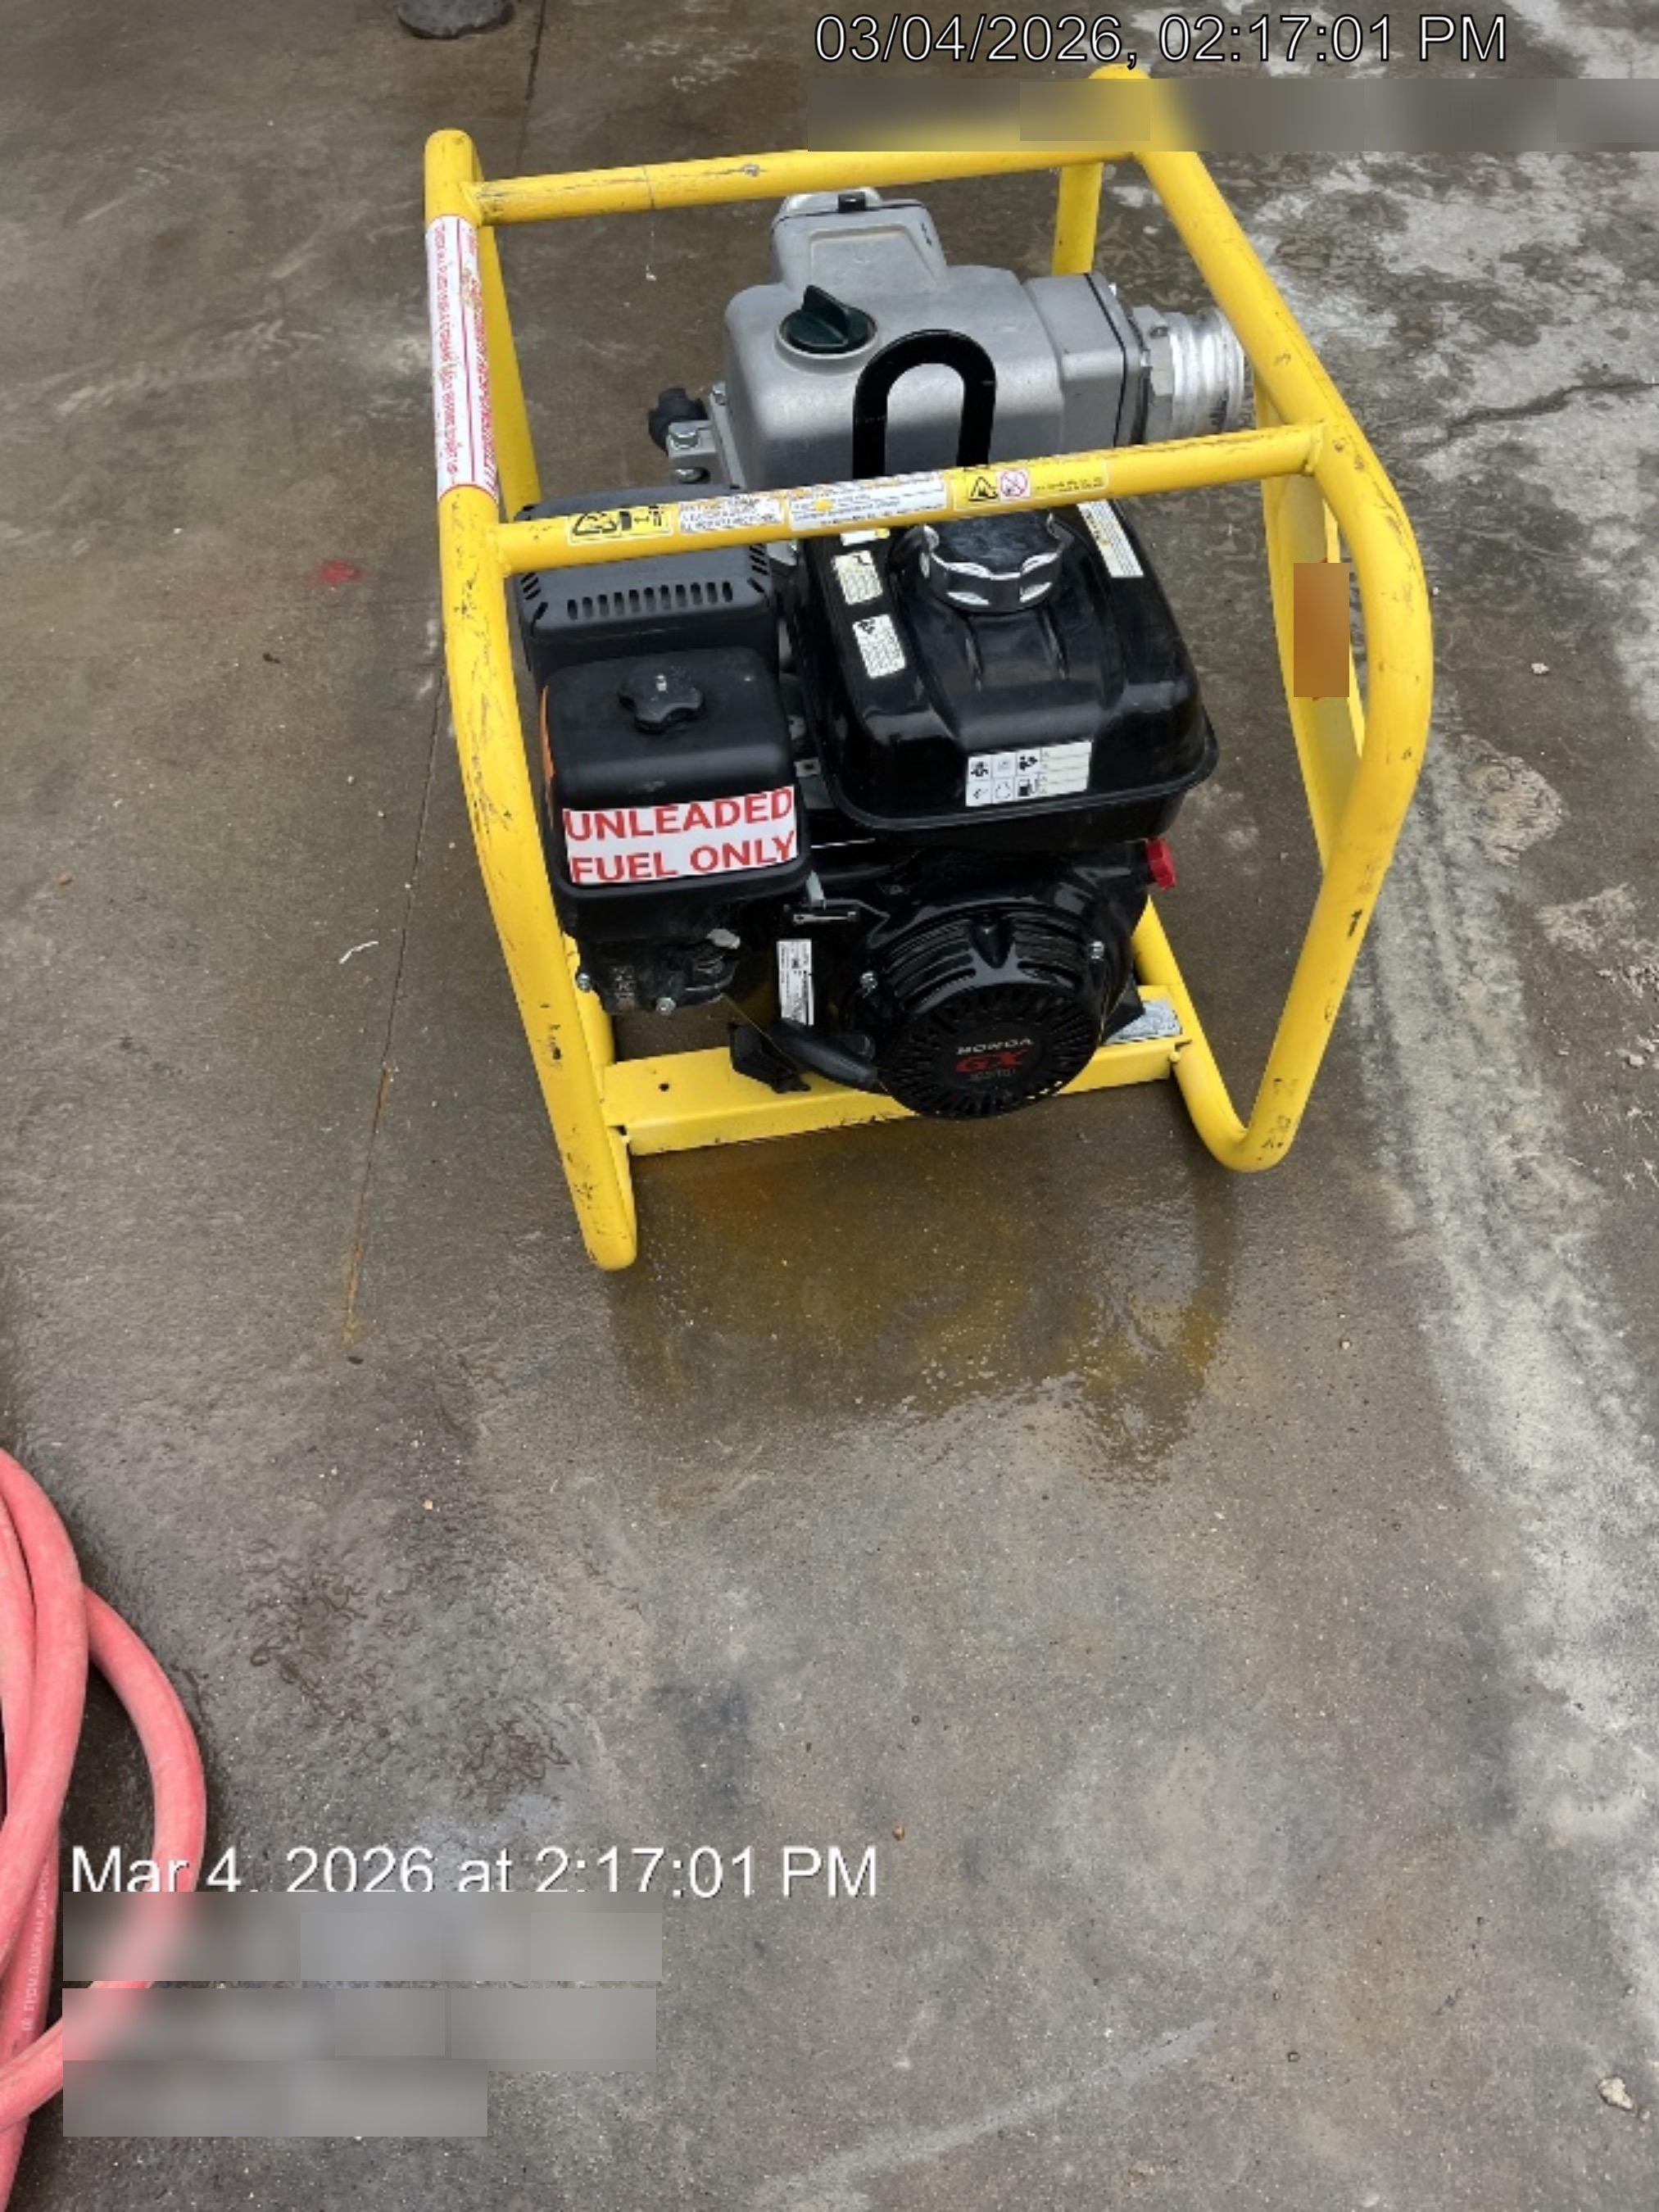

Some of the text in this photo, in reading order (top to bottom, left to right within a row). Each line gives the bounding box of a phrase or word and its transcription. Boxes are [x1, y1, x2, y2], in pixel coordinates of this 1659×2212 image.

[563, 786, 793, 841] UNLEADED
[571, 830, 794, 882] FUEL ONLY
[956, 1037, 1034, 1055] HONDA
